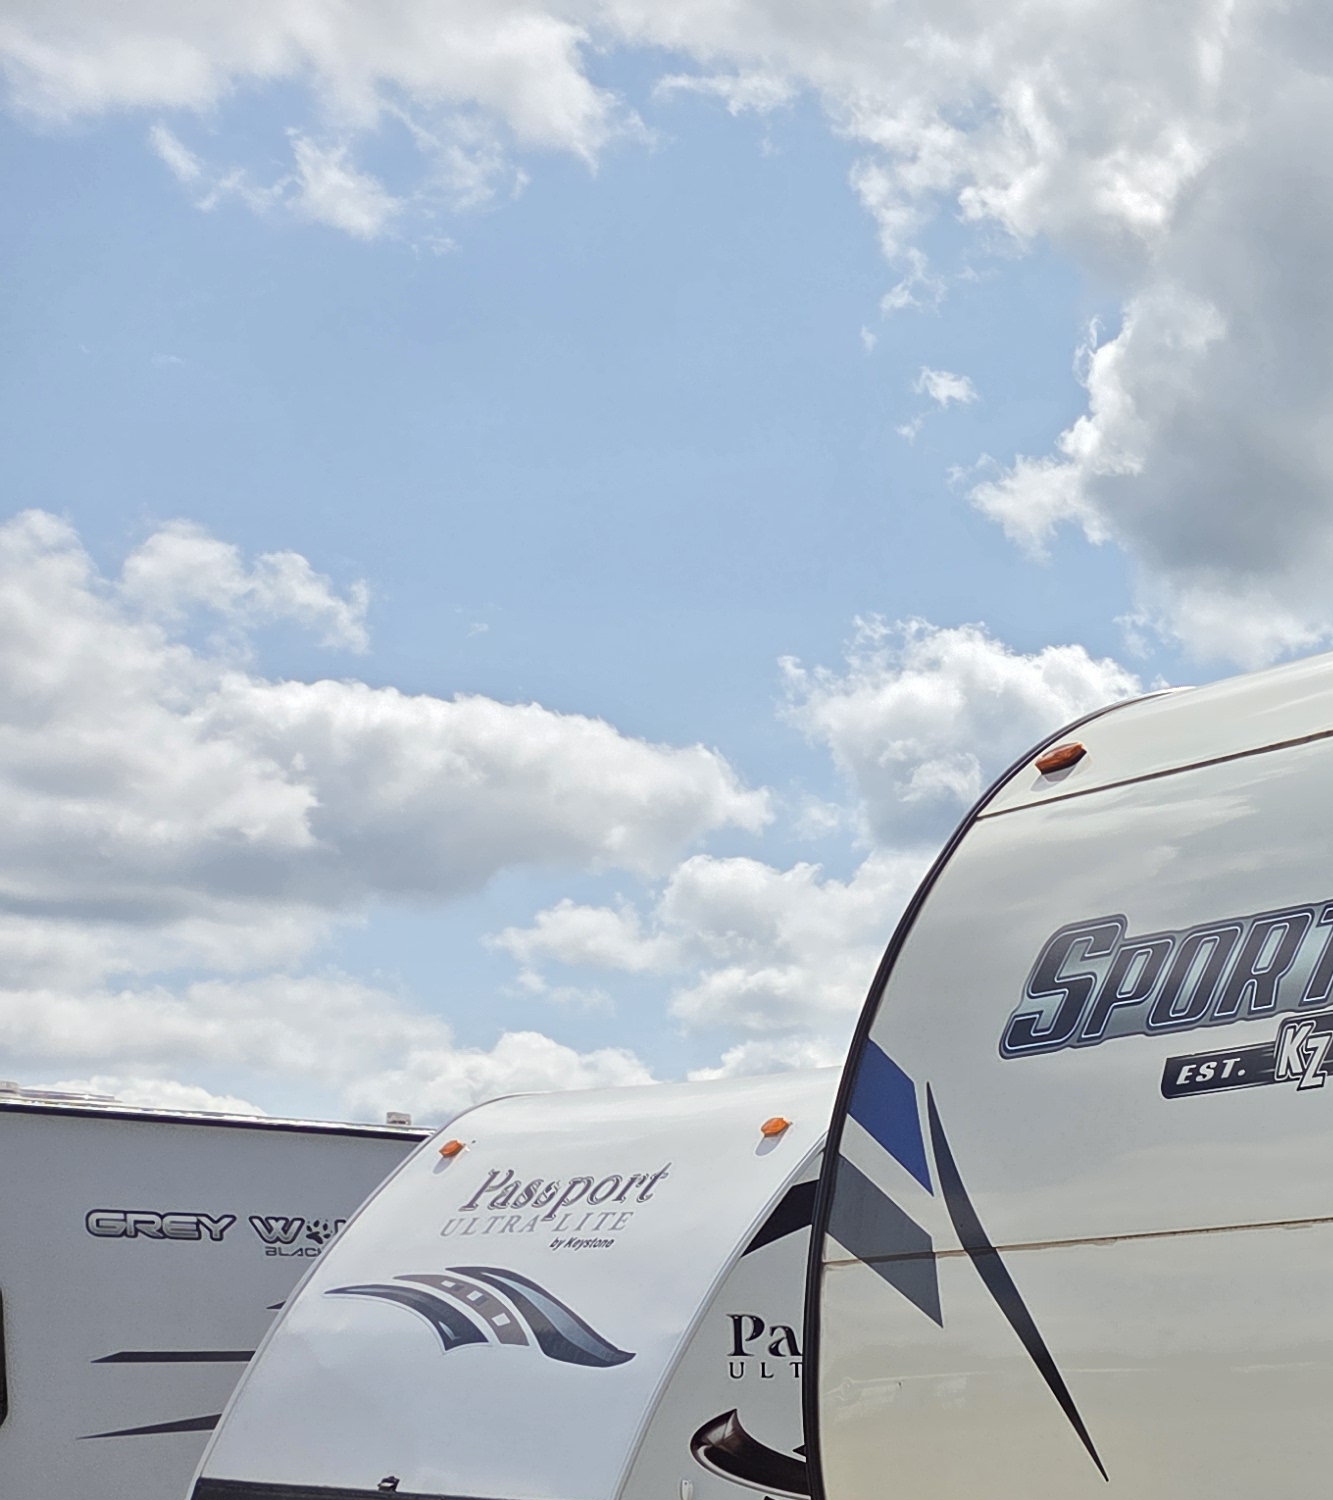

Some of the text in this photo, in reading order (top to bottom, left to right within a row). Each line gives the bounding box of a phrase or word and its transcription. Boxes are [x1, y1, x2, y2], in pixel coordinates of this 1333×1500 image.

[1174, 1056, 1247, 1087] EST.
[458, 1162, 672, 1222] Passport
[86, 1209, 237, 1241] GREY
[440, 1211, 635, 1237] ULTRA LITE
[550, 1237, 615, 1250] by Keystone
